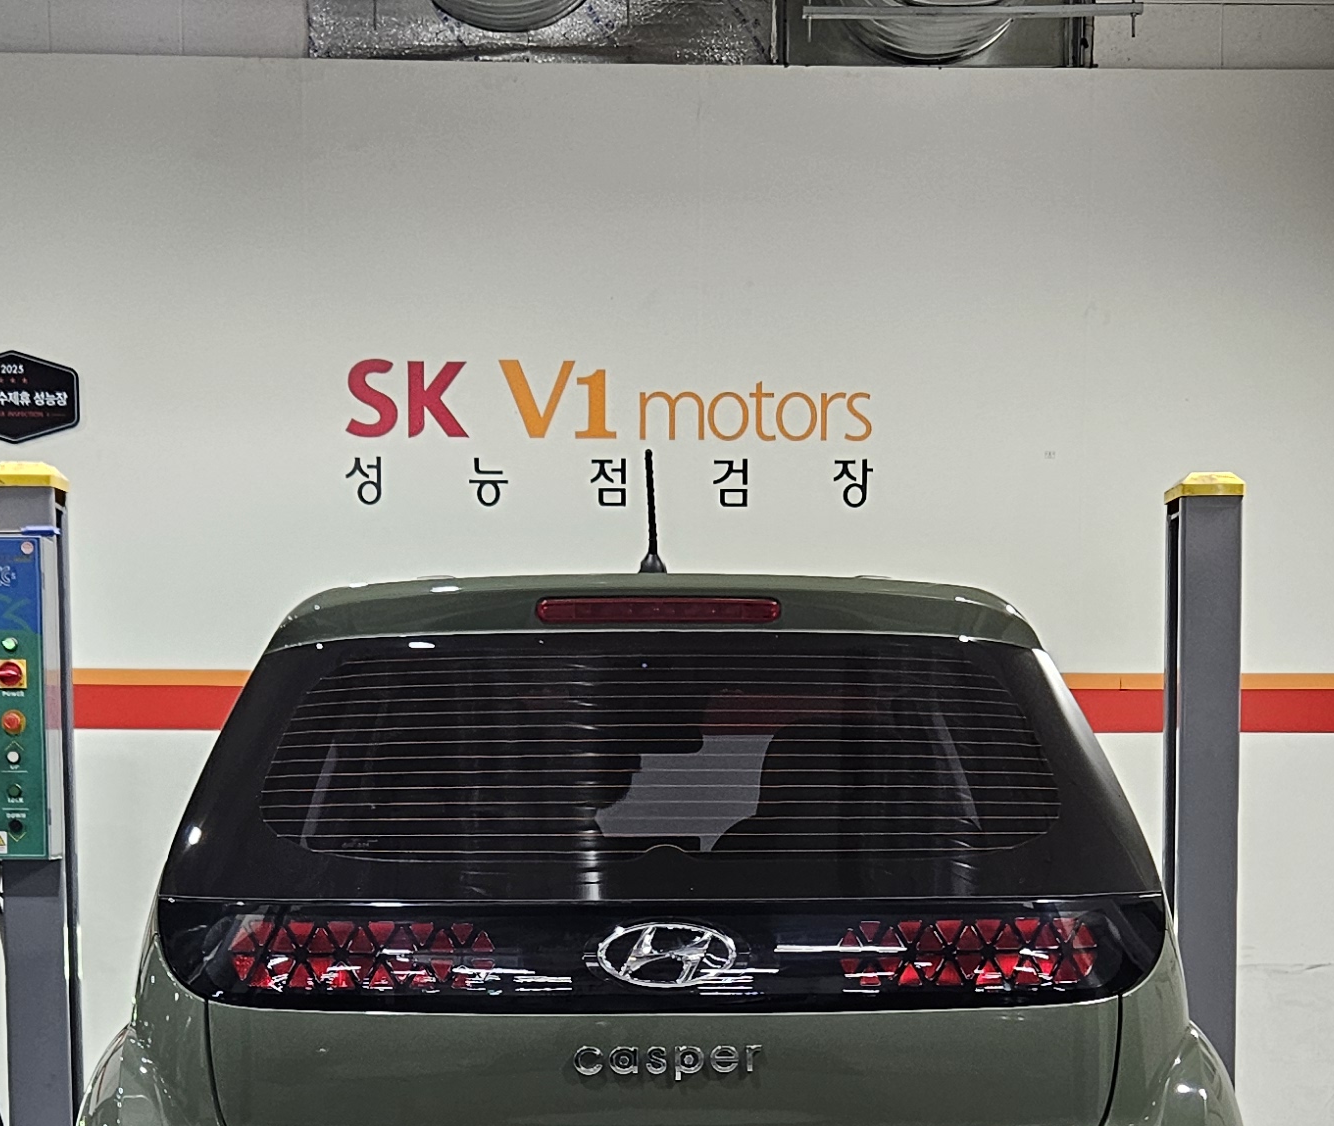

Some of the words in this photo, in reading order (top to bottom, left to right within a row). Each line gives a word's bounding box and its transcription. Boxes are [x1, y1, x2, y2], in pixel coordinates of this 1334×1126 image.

[0, 364, 24, 374] 2025
[33, 391, 68, 406] 성능장
[345, 358, 469, 438] SK
[498, 359, 617, 439] V1
[639, 381, 872, 442] motors
[573, 1044, 763, 1081] casper
